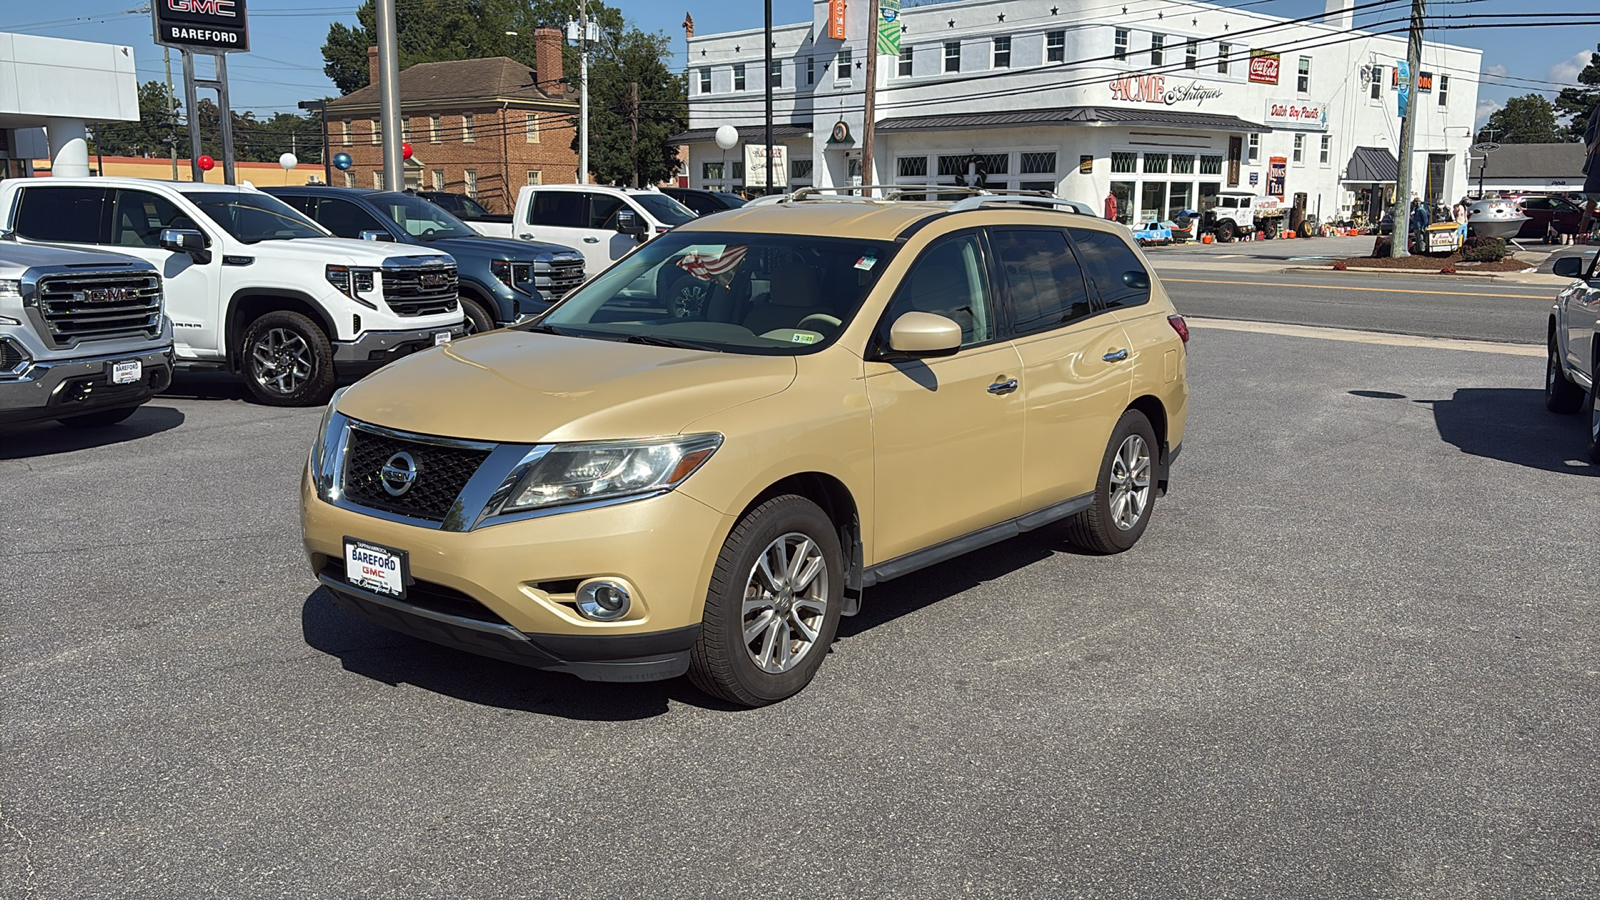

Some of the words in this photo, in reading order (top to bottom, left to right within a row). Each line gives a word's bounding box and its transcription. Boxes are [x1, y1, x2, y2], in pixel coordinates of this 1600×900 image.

[167, 0, 236, 17] GMC
[171, 27, 237, 43] BAREFORD
[1109, 72, 1165, 104] ACME
[1271, 104, 1287, 117] Dutch
[1289, 105, 1300, 120] Boy
[1300, 106, 1319, 119] Paints
[1271, 182, 1283, 194] TEA
[90, 287, 138, 302] GMC
[115, 363, 139, 373] BAREFORD
[352, 549, 396, 571] BAREFORD
[362, 565, 386, 579] GMC
